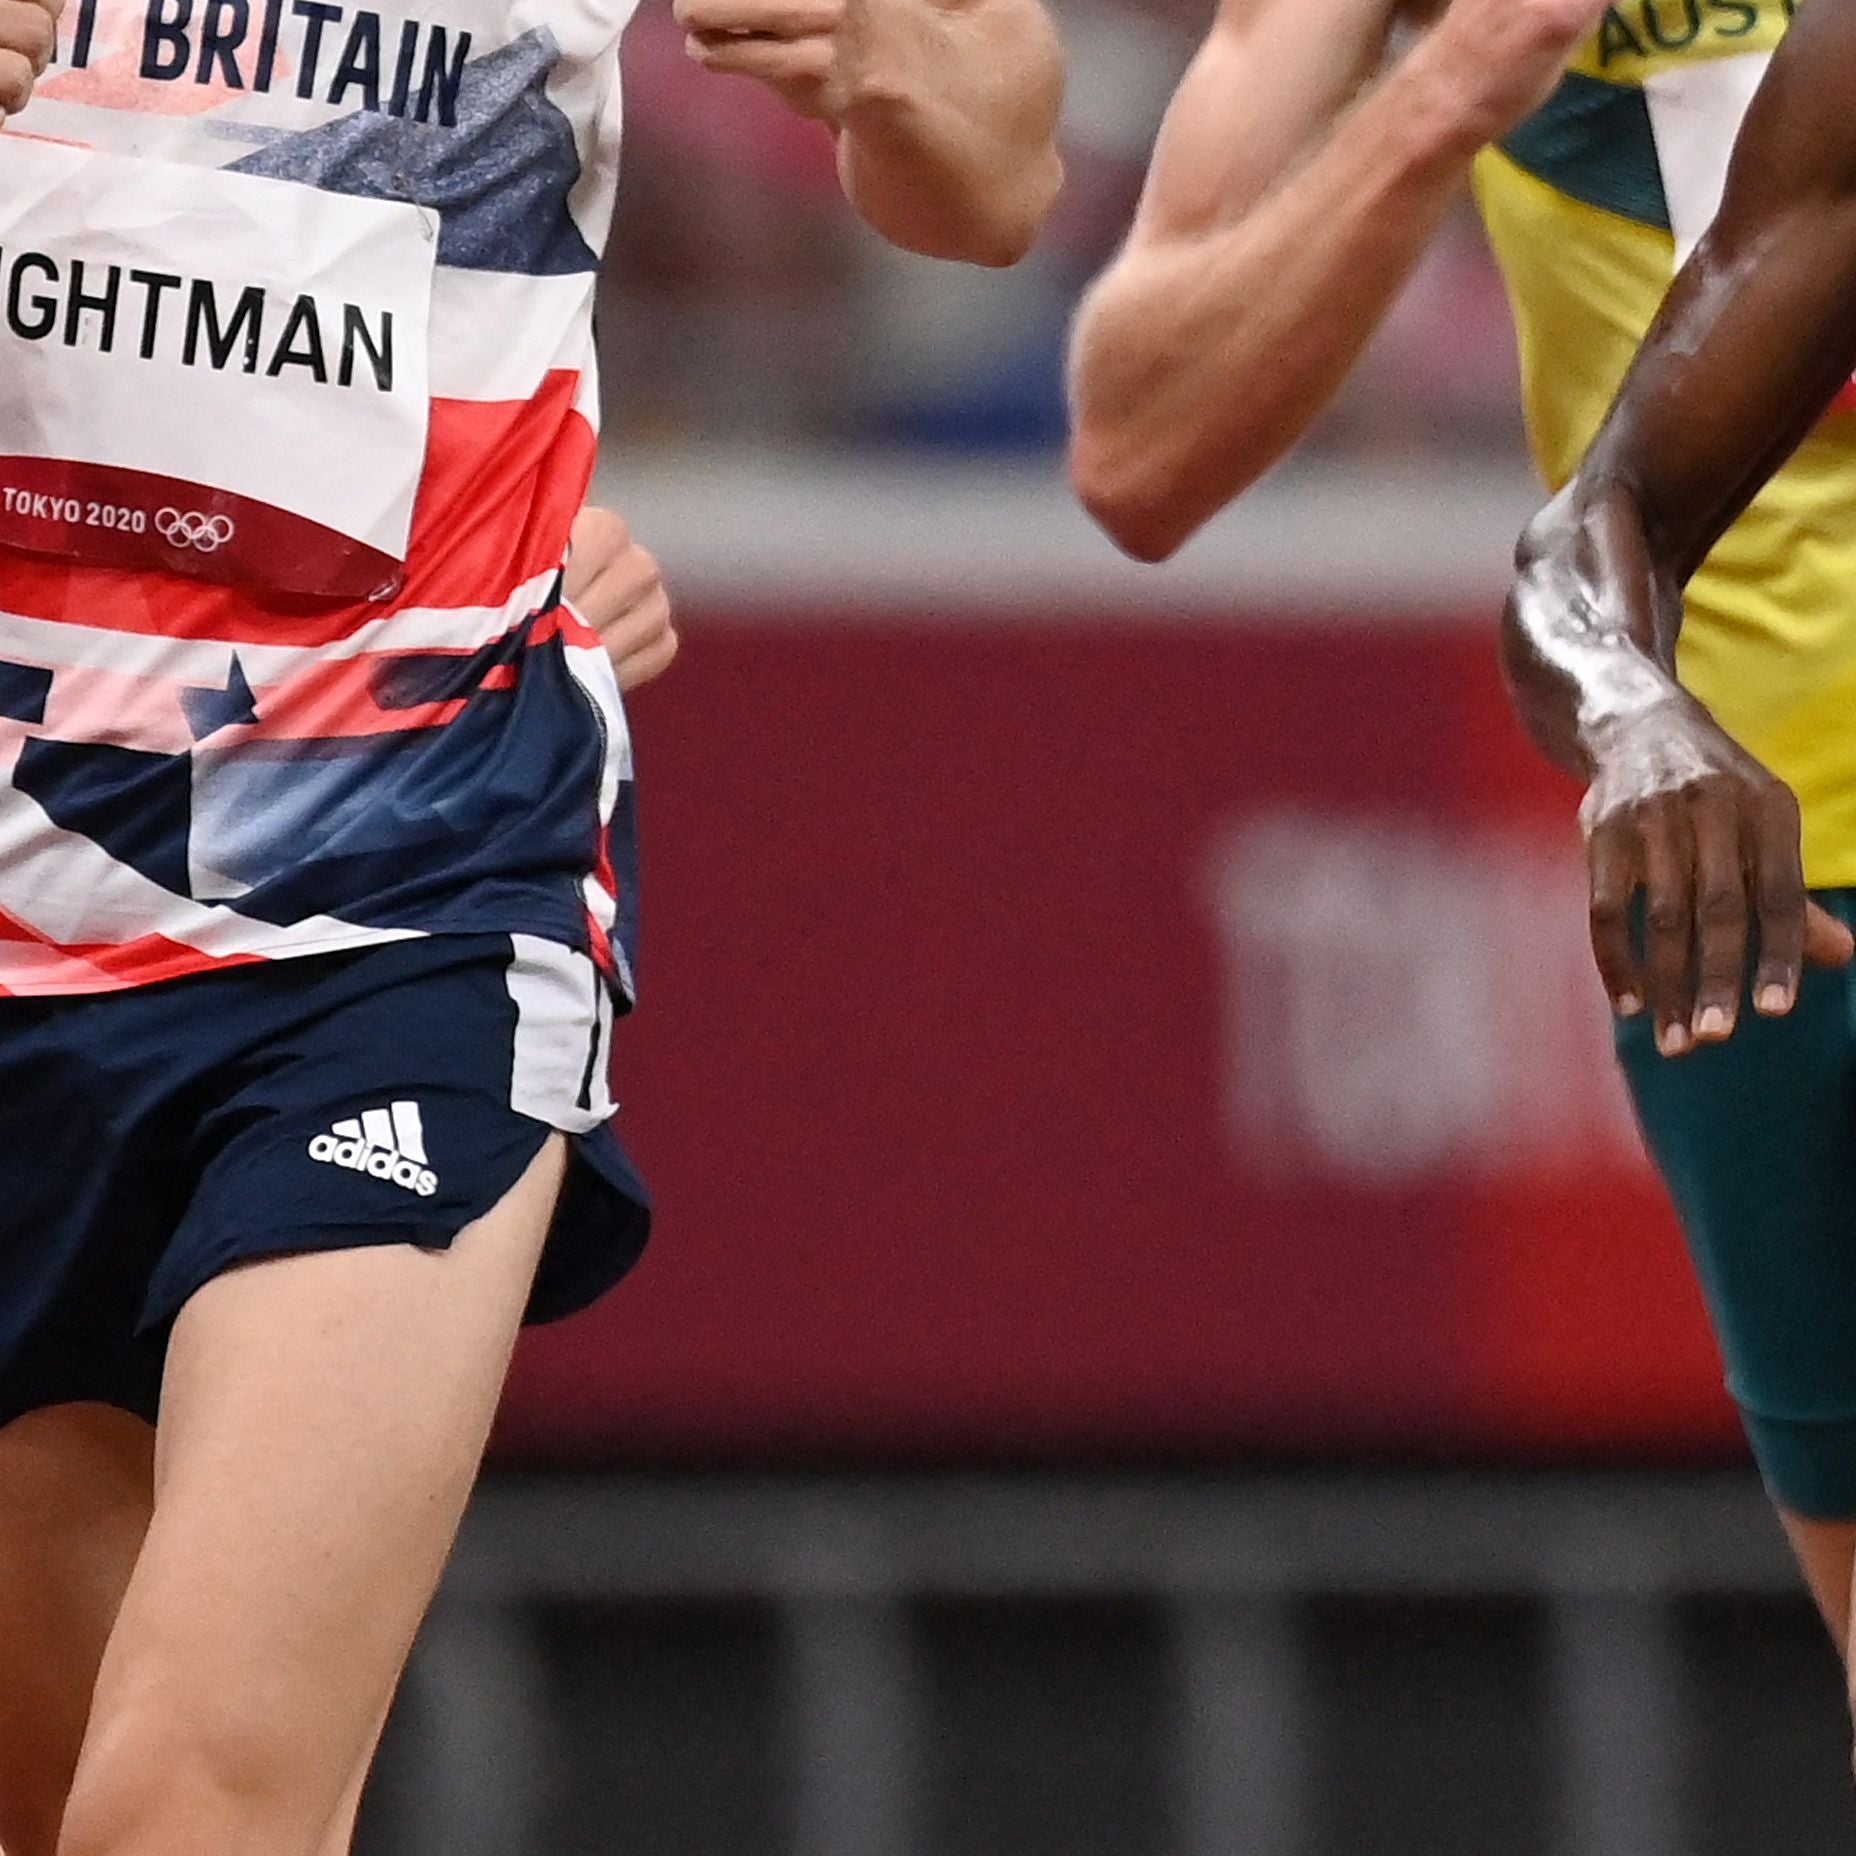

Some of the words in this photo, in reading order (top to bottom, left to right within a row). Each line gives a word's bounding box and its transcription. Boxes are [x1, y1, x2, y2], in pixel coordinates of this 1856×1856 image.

[3, 487, 80, 523] TOKYO
[86, 502, 146, 534] 2020
[308, 1134, 438, 1197] adidas
